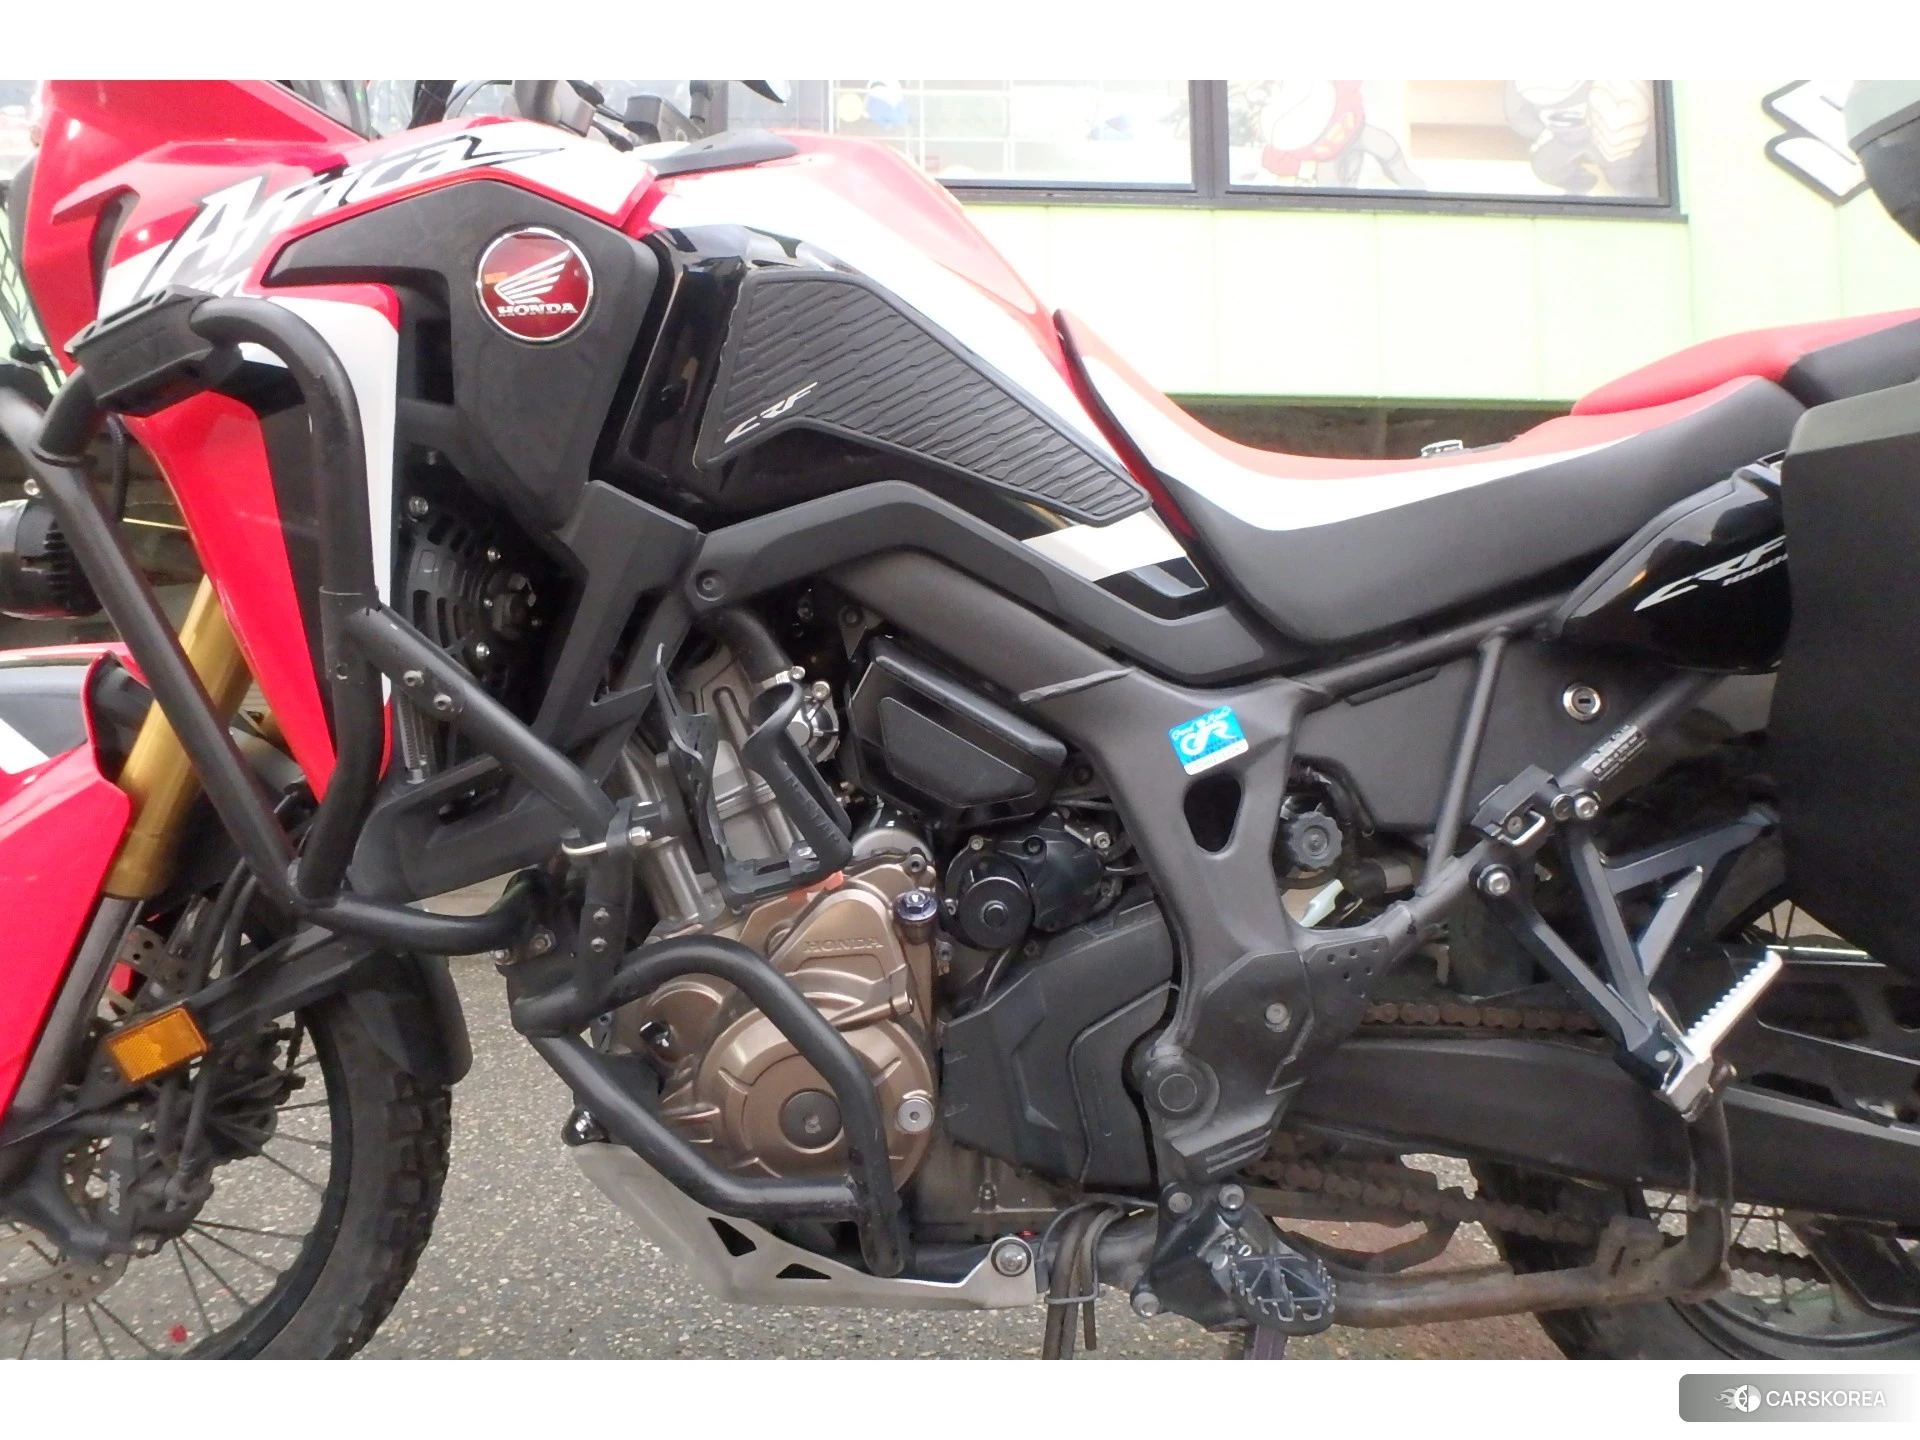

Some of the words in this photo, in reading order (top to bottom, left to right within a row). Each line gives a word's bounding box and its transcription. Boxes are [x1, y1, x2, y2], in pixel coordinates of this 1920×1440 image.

[496, 302, 578, 317] HONDA
[724, 382, 818, 444] CRF
[1633, 534, 1788, 612] CRF
[803, 937, 884, 953] HONDA
